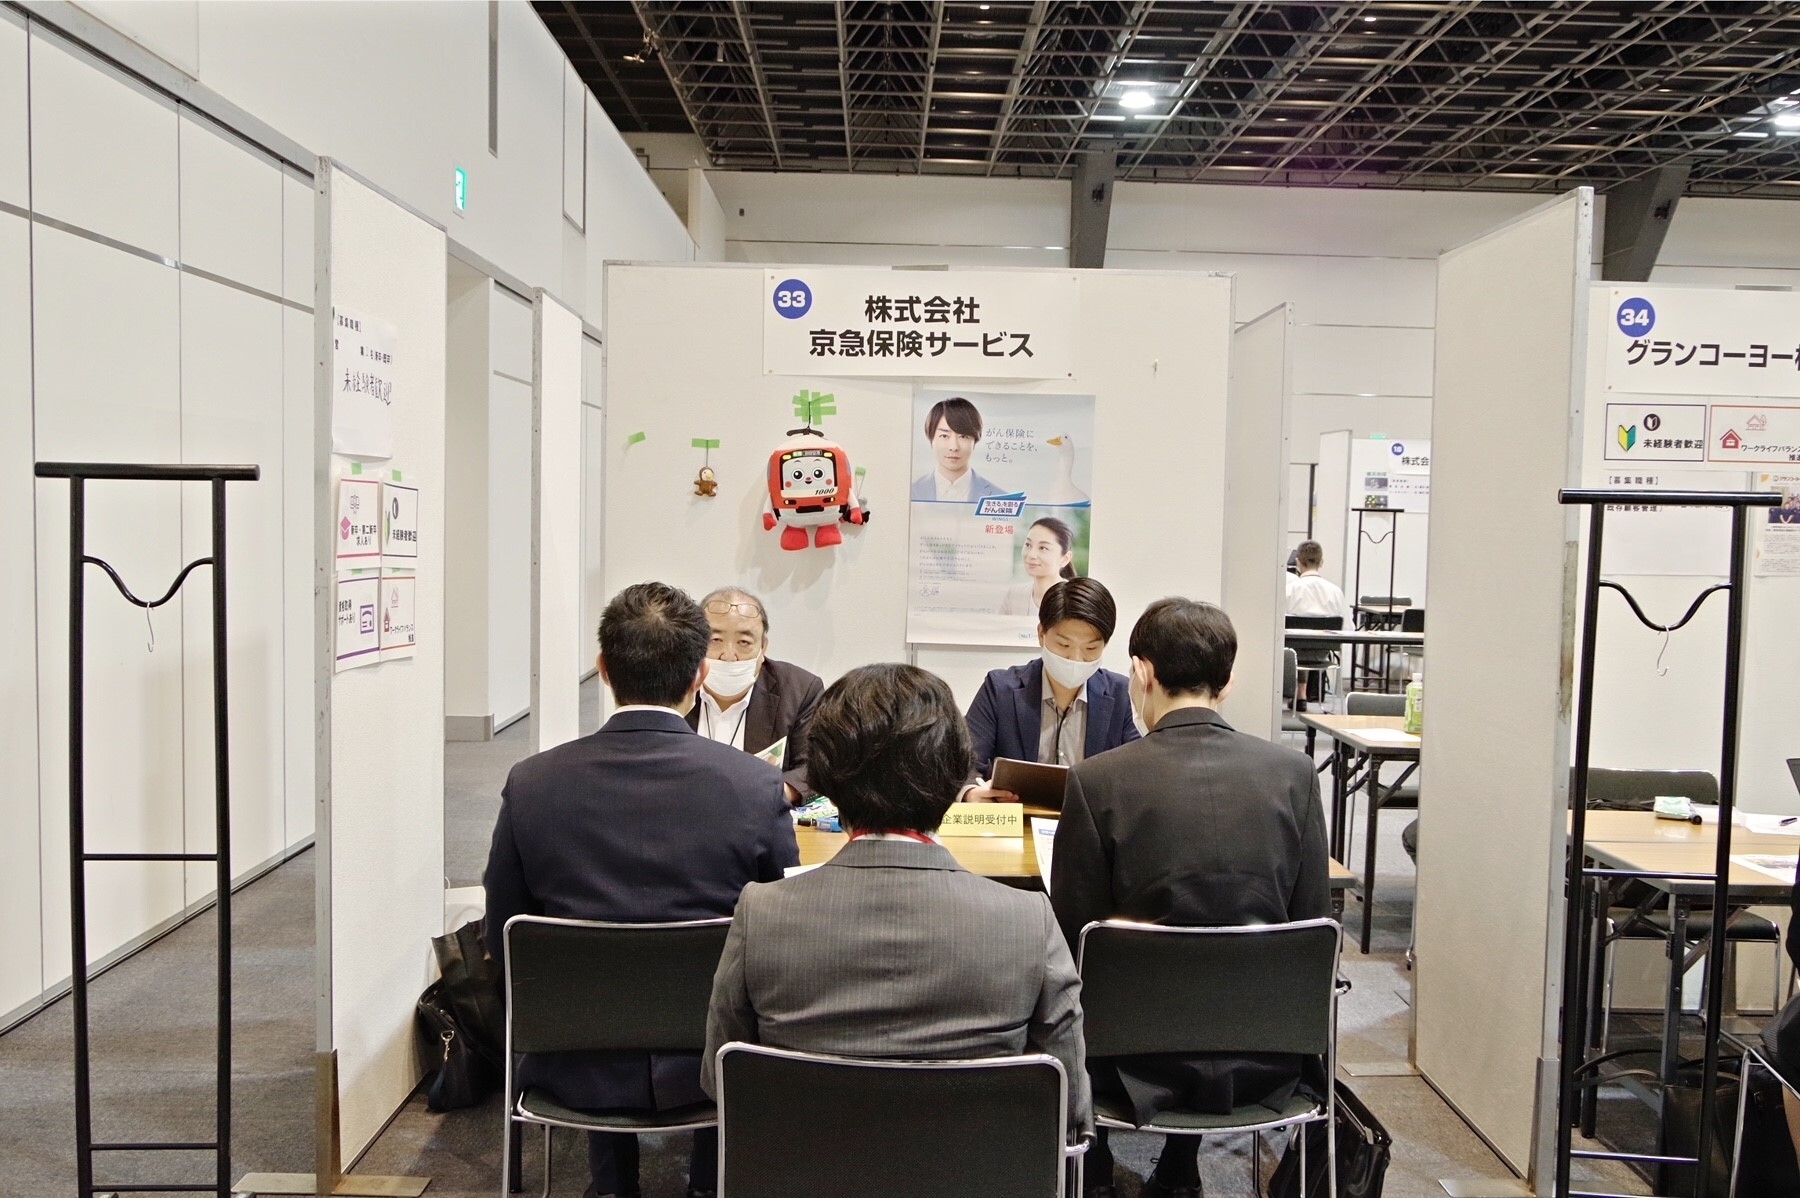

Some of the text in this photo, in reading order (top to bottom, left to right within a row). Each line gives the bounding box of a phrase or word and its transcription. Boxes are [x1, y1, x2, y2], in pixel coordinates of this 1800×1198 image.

[777, 290, 806, 308] 33
[864, 295, 981, 324] 株式会社
[1620, 308, 1649, 326] 34
[808, 328, 1034, 358] 京急保険サービス
[985, 428, 1035, 438] がん保険に
[985, 441, 1038, 452] できることを、
[1643, 439, 1703, 449] 未経験者歓迎
[984, 453, 1014, 464] もっと。
[985, 524, 1014, 535] 新登場
[942, 813, 1018, 826] 企業説明受付中
